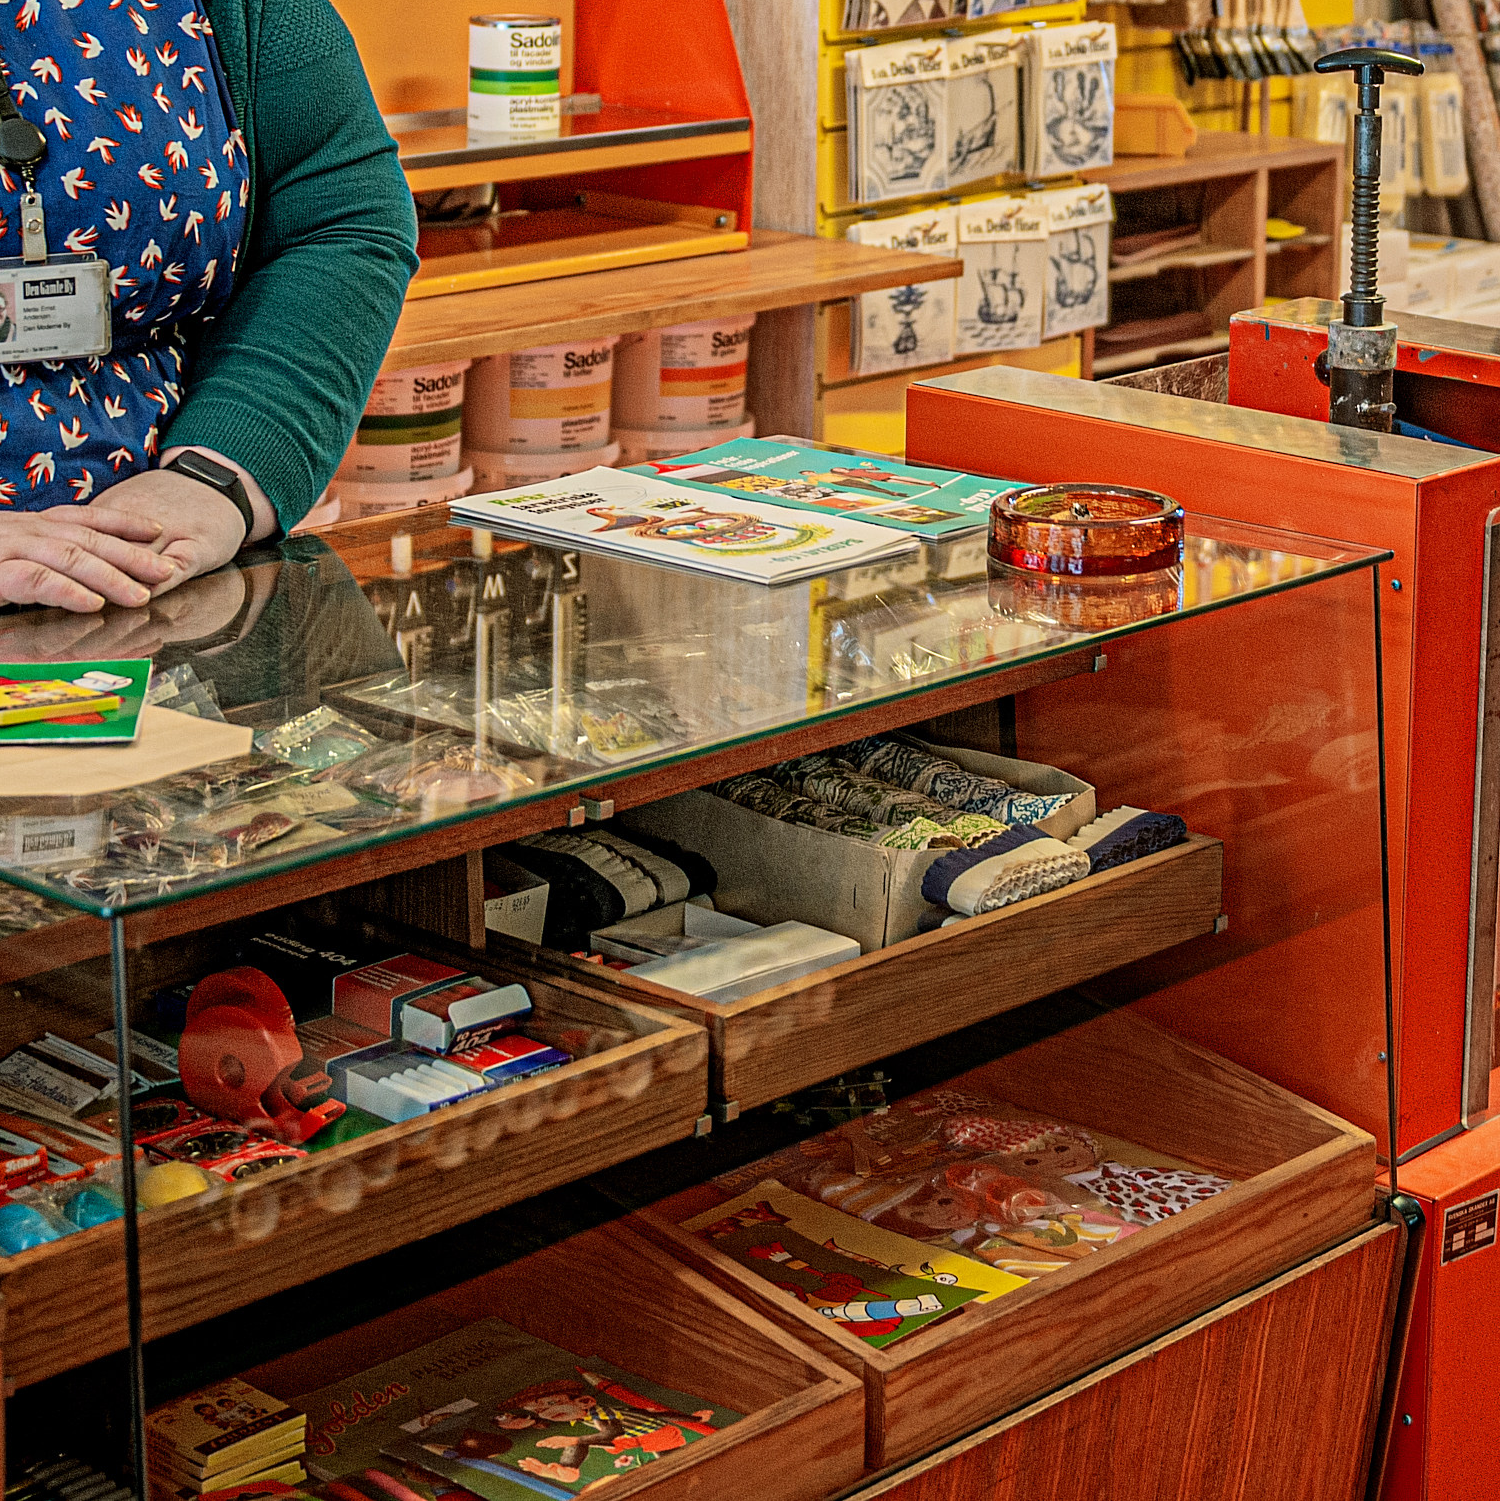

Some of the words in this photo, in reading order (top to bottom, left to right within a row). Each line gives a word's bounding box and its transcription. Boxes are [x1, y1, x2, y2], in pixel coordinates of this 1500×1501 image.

[25, 282, 40, 297] Den
[41, 280, 64, 296] Gamle
[64, 278, 74, 295] By
[318, 949, 358, 967] 404
[453, 1033, 490, 1053] 404
